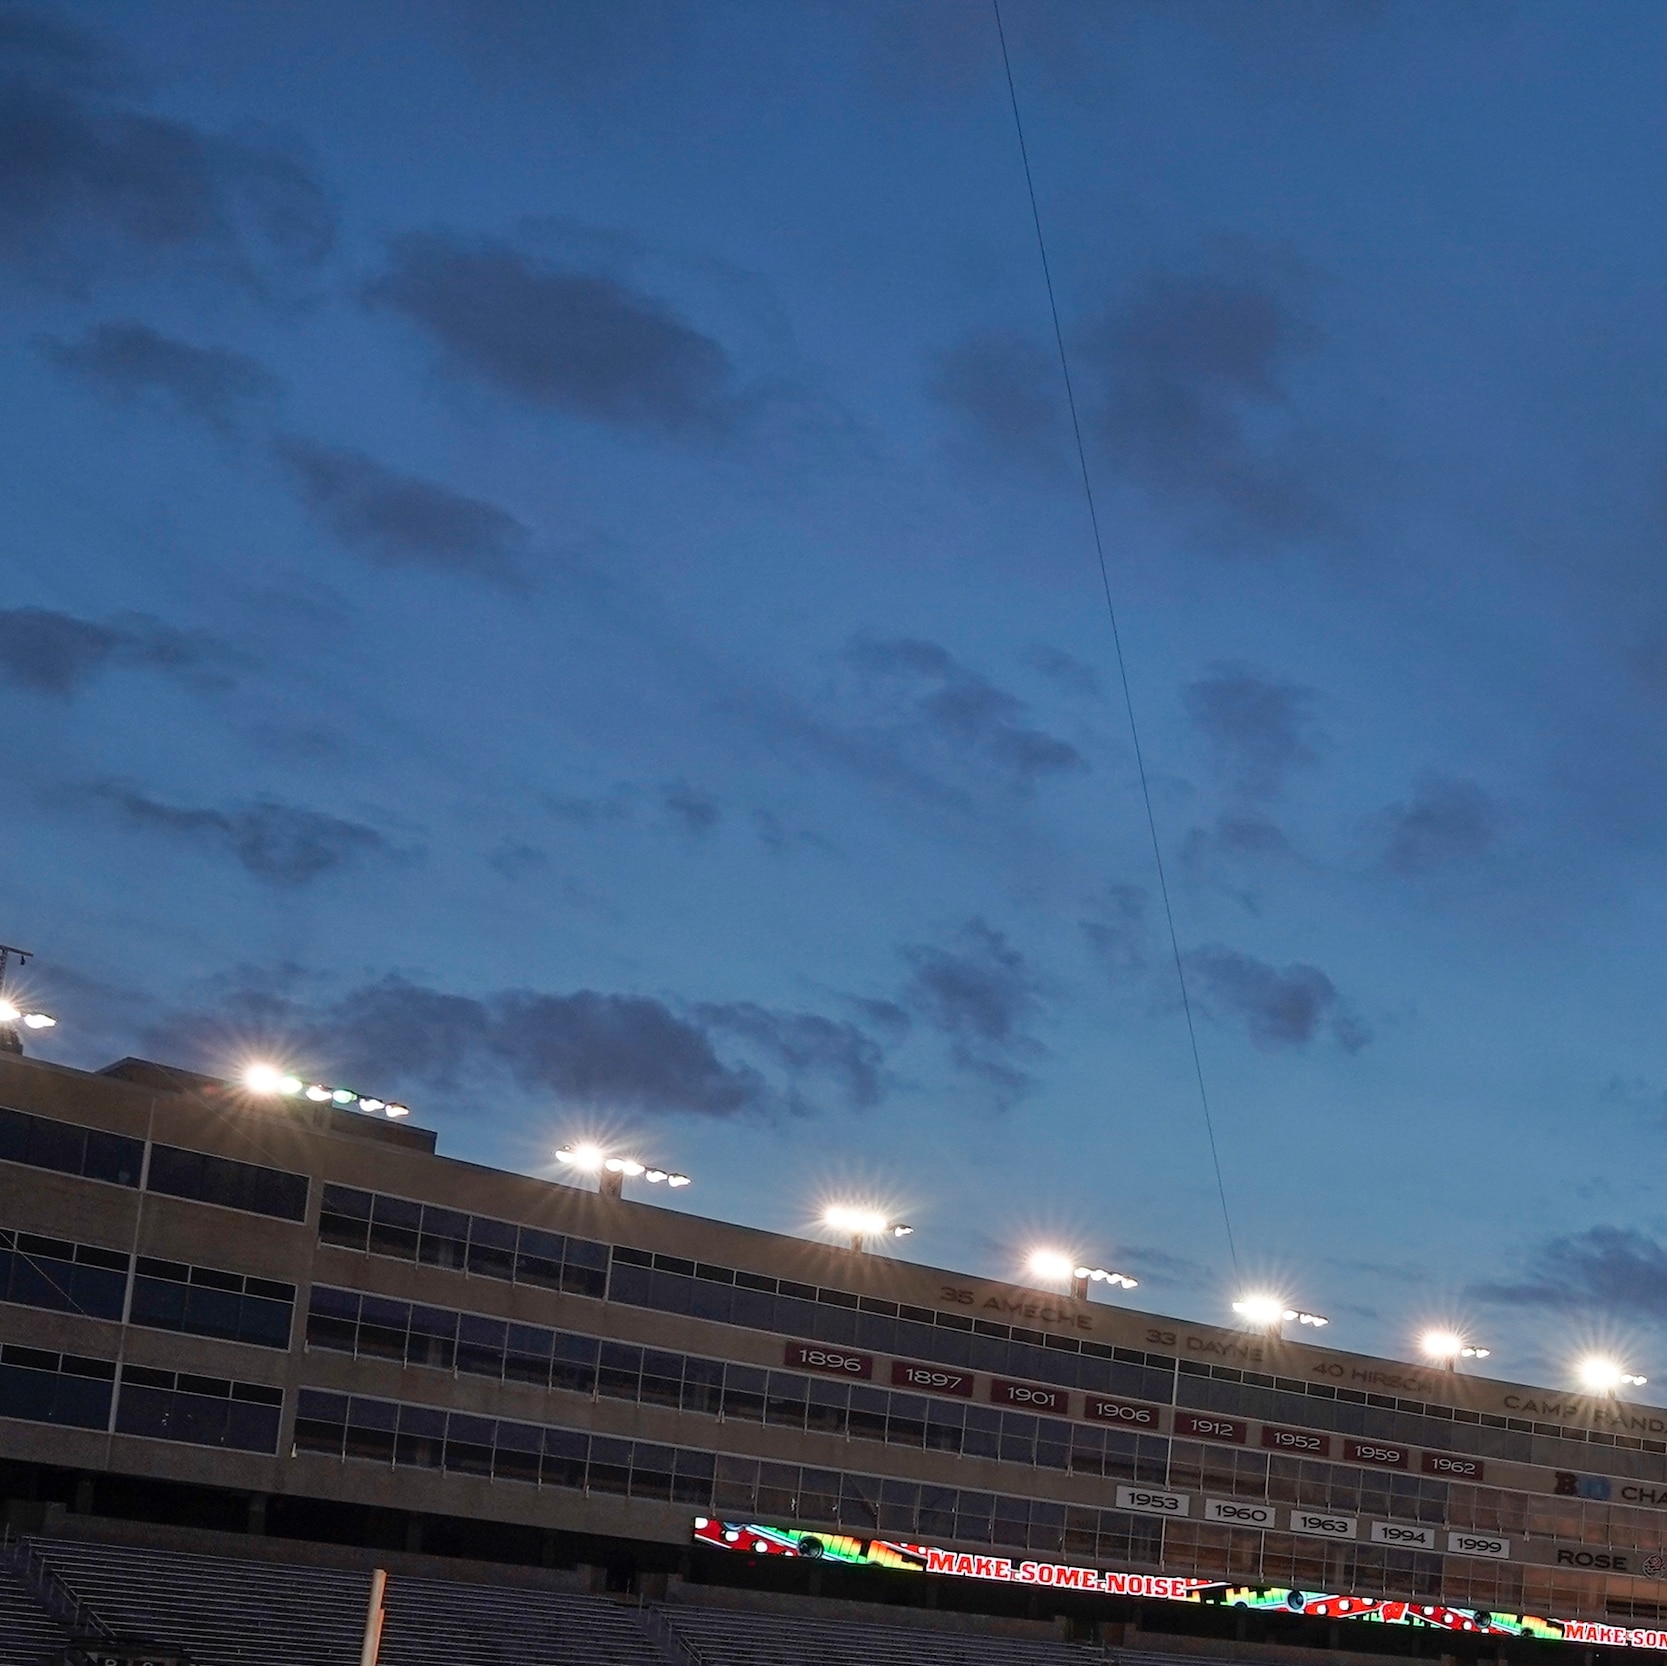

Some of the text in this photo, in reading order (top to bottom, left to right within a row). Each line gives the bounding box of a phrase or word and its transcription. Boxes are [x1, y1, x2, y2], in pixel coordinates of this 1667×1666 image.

[940, 1286, 1093, 1331] 35 AMECHE
[1146, 1328, 1264, 1363] 33 DAYNE
[797, 1346, 862, 1374] 1896
[905, 1366, 963, 1392] 1897
[1312, 1361, 1434, 1394] 40 HIRSCH
[1007, 1385, 1057, 1408] 1901
[1095, 1402, 1152, 1424] 1906
[1503, 1394, 1577, 1421] CAMP
[1190, 1418, 1233, 1438] 1912
[1273, 1431, 1321, 1451] 1952
[1354, 1444, 1400, 1463] 1959
[1431, 1456, 1476, 1475] 1962
[1128, 1492, 1178, 1511] 1953
[1214, 1504, 1267, 1522] 1960
[1301, 1515, 1348, 1533] 1963
[1381, 1526, 1426, 1544] 1994
[1457, 1537, 1502, 1554] 1999
[1557, 1549, 1628, 1570] ROSE
[926, 1549, 1186, 1599] MAKE SOME NOISE
[1563, 1621, 1629, 1644] MAKE
